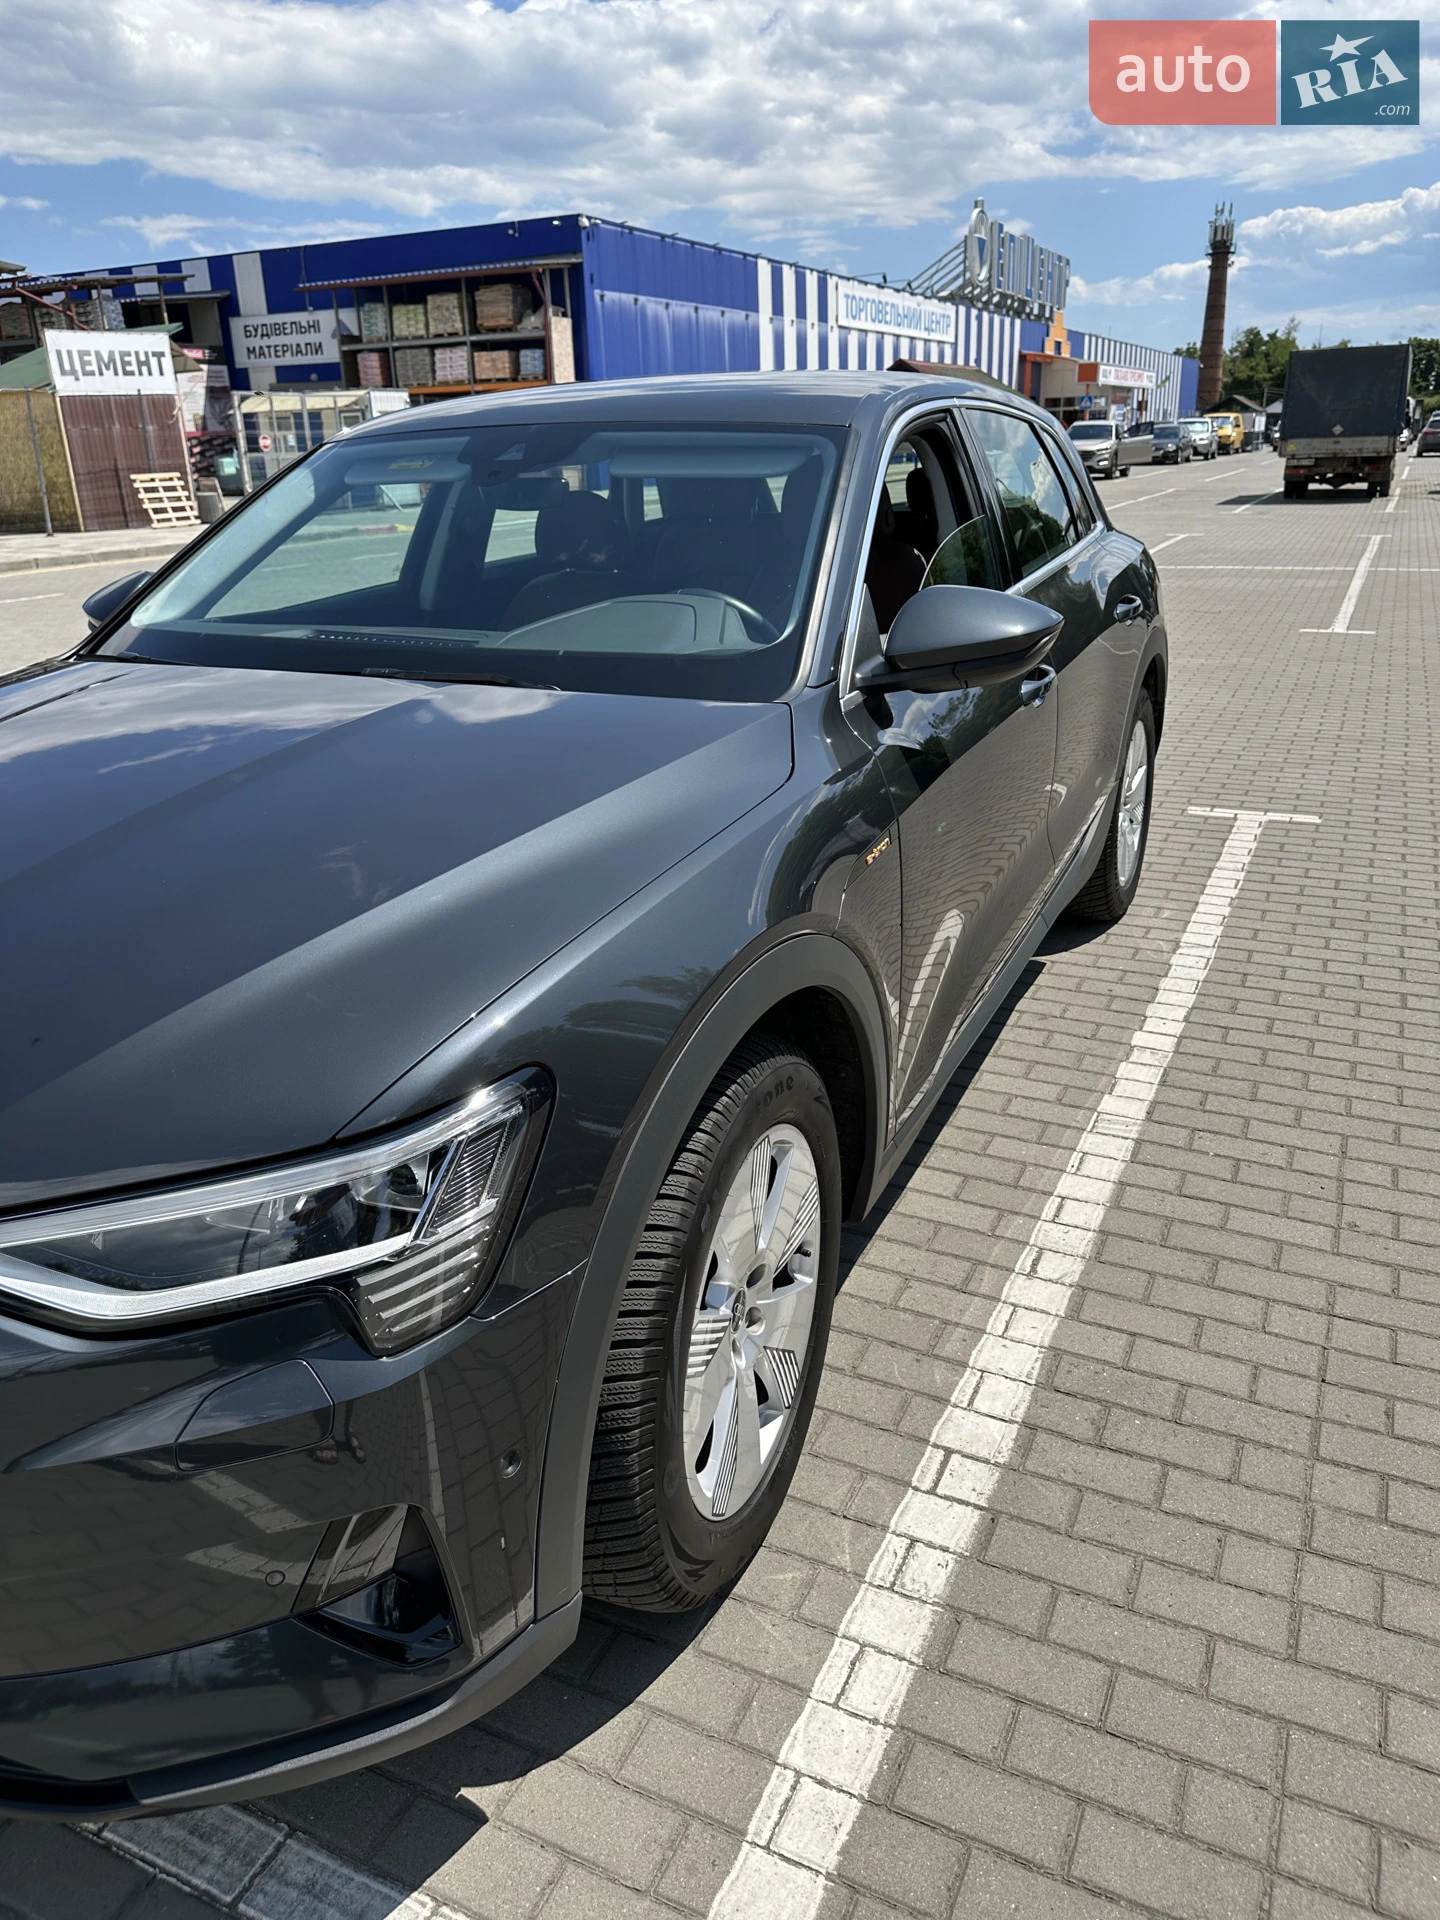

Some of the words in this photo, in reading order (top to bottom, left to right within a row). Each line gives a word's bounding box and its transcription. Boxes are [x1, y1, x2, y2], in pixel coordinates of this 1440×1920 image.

[844, 293, 921, 331] ТОРГОВЕЛЬНИЙ
[923, 309, 951, 336] ЦЕНТР
[243, 319, 321, 340] БУДІВЕЛЬНІ
[246, 341, 324, 360] МАТЕРІАЛИ
[55, 349, 166, 381] ЦЕМЕНТ
